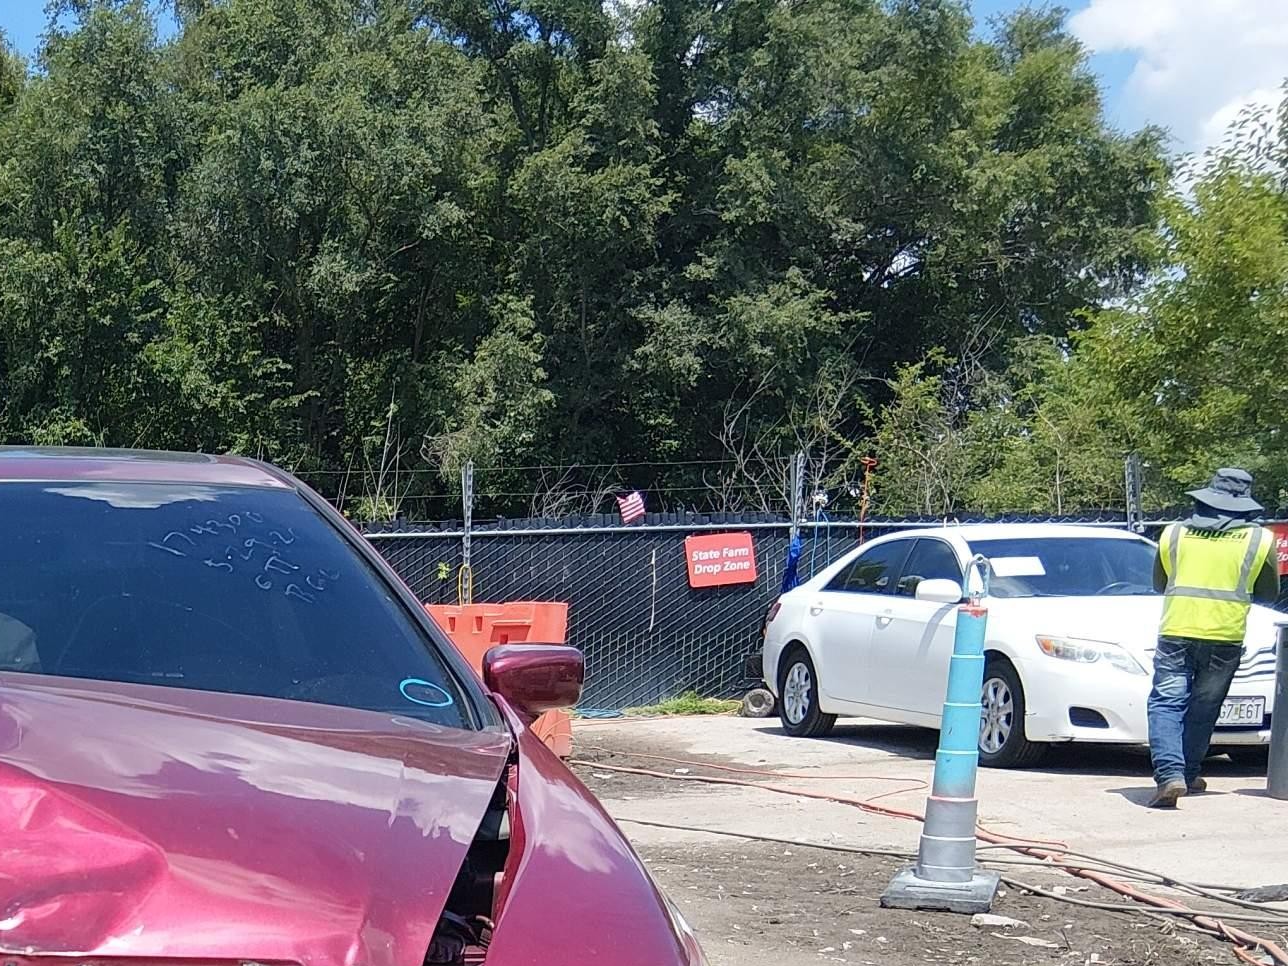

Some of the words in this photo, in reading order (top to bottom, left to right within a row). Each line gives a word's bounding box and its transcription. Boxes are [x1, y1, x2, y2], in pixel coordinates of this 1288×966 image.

[692, 550, 720, 561] State
[722, 547, 749, 558] Farm
[694, 564, 722, 575] Drop
[723, 561, 751, 571] Zone
